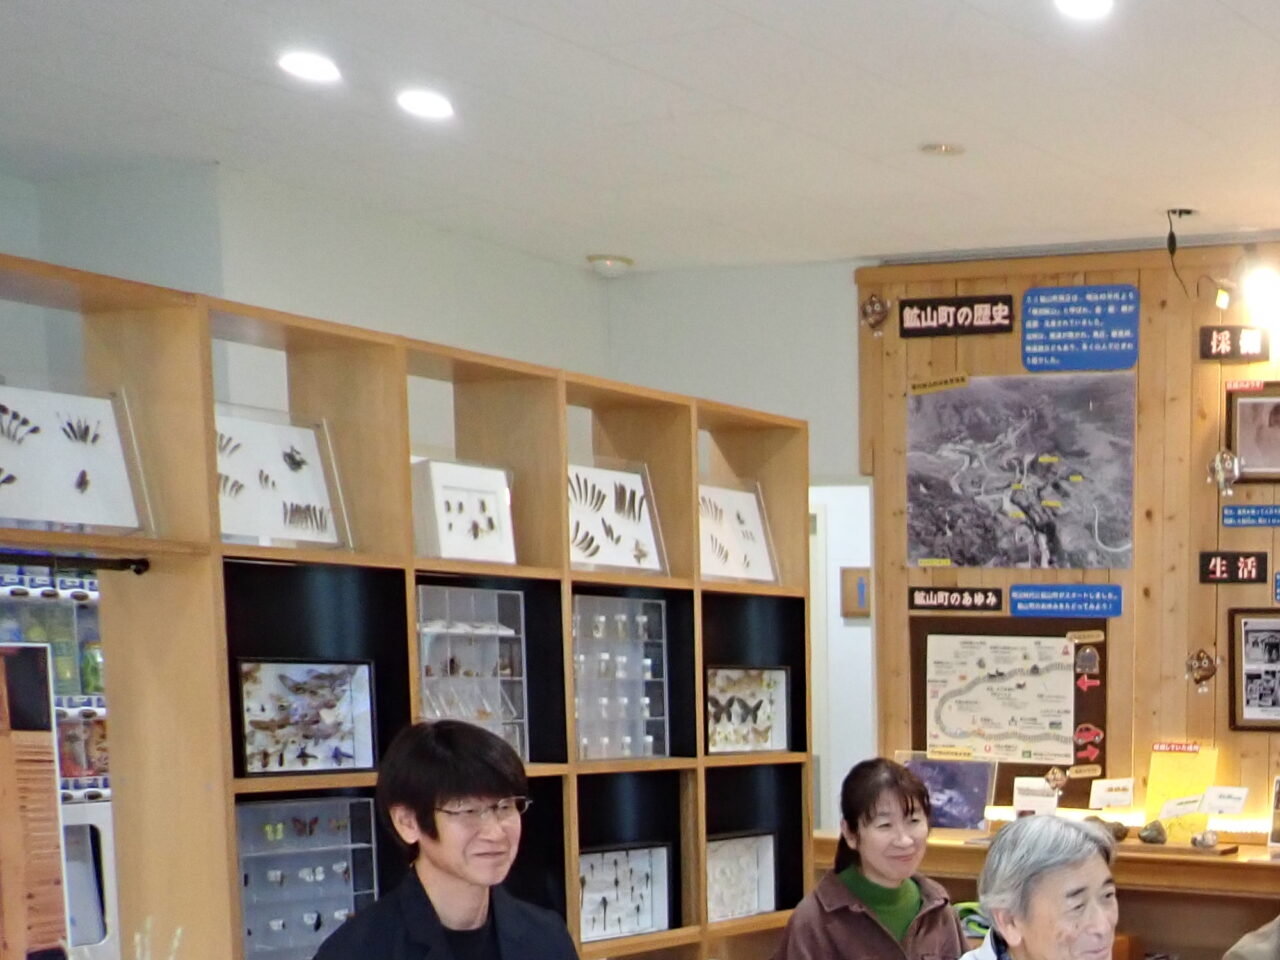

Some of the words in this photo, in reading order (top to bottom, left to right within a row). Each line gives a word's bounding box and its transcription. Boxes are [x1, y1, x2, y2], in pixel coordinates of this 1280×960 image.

[903, 302, 1010, 328] 鉱山町の歴史
[1208, 556, 1257, 580] 生活
[914, 590, 997, 607] 鉱山町のあゆみ
